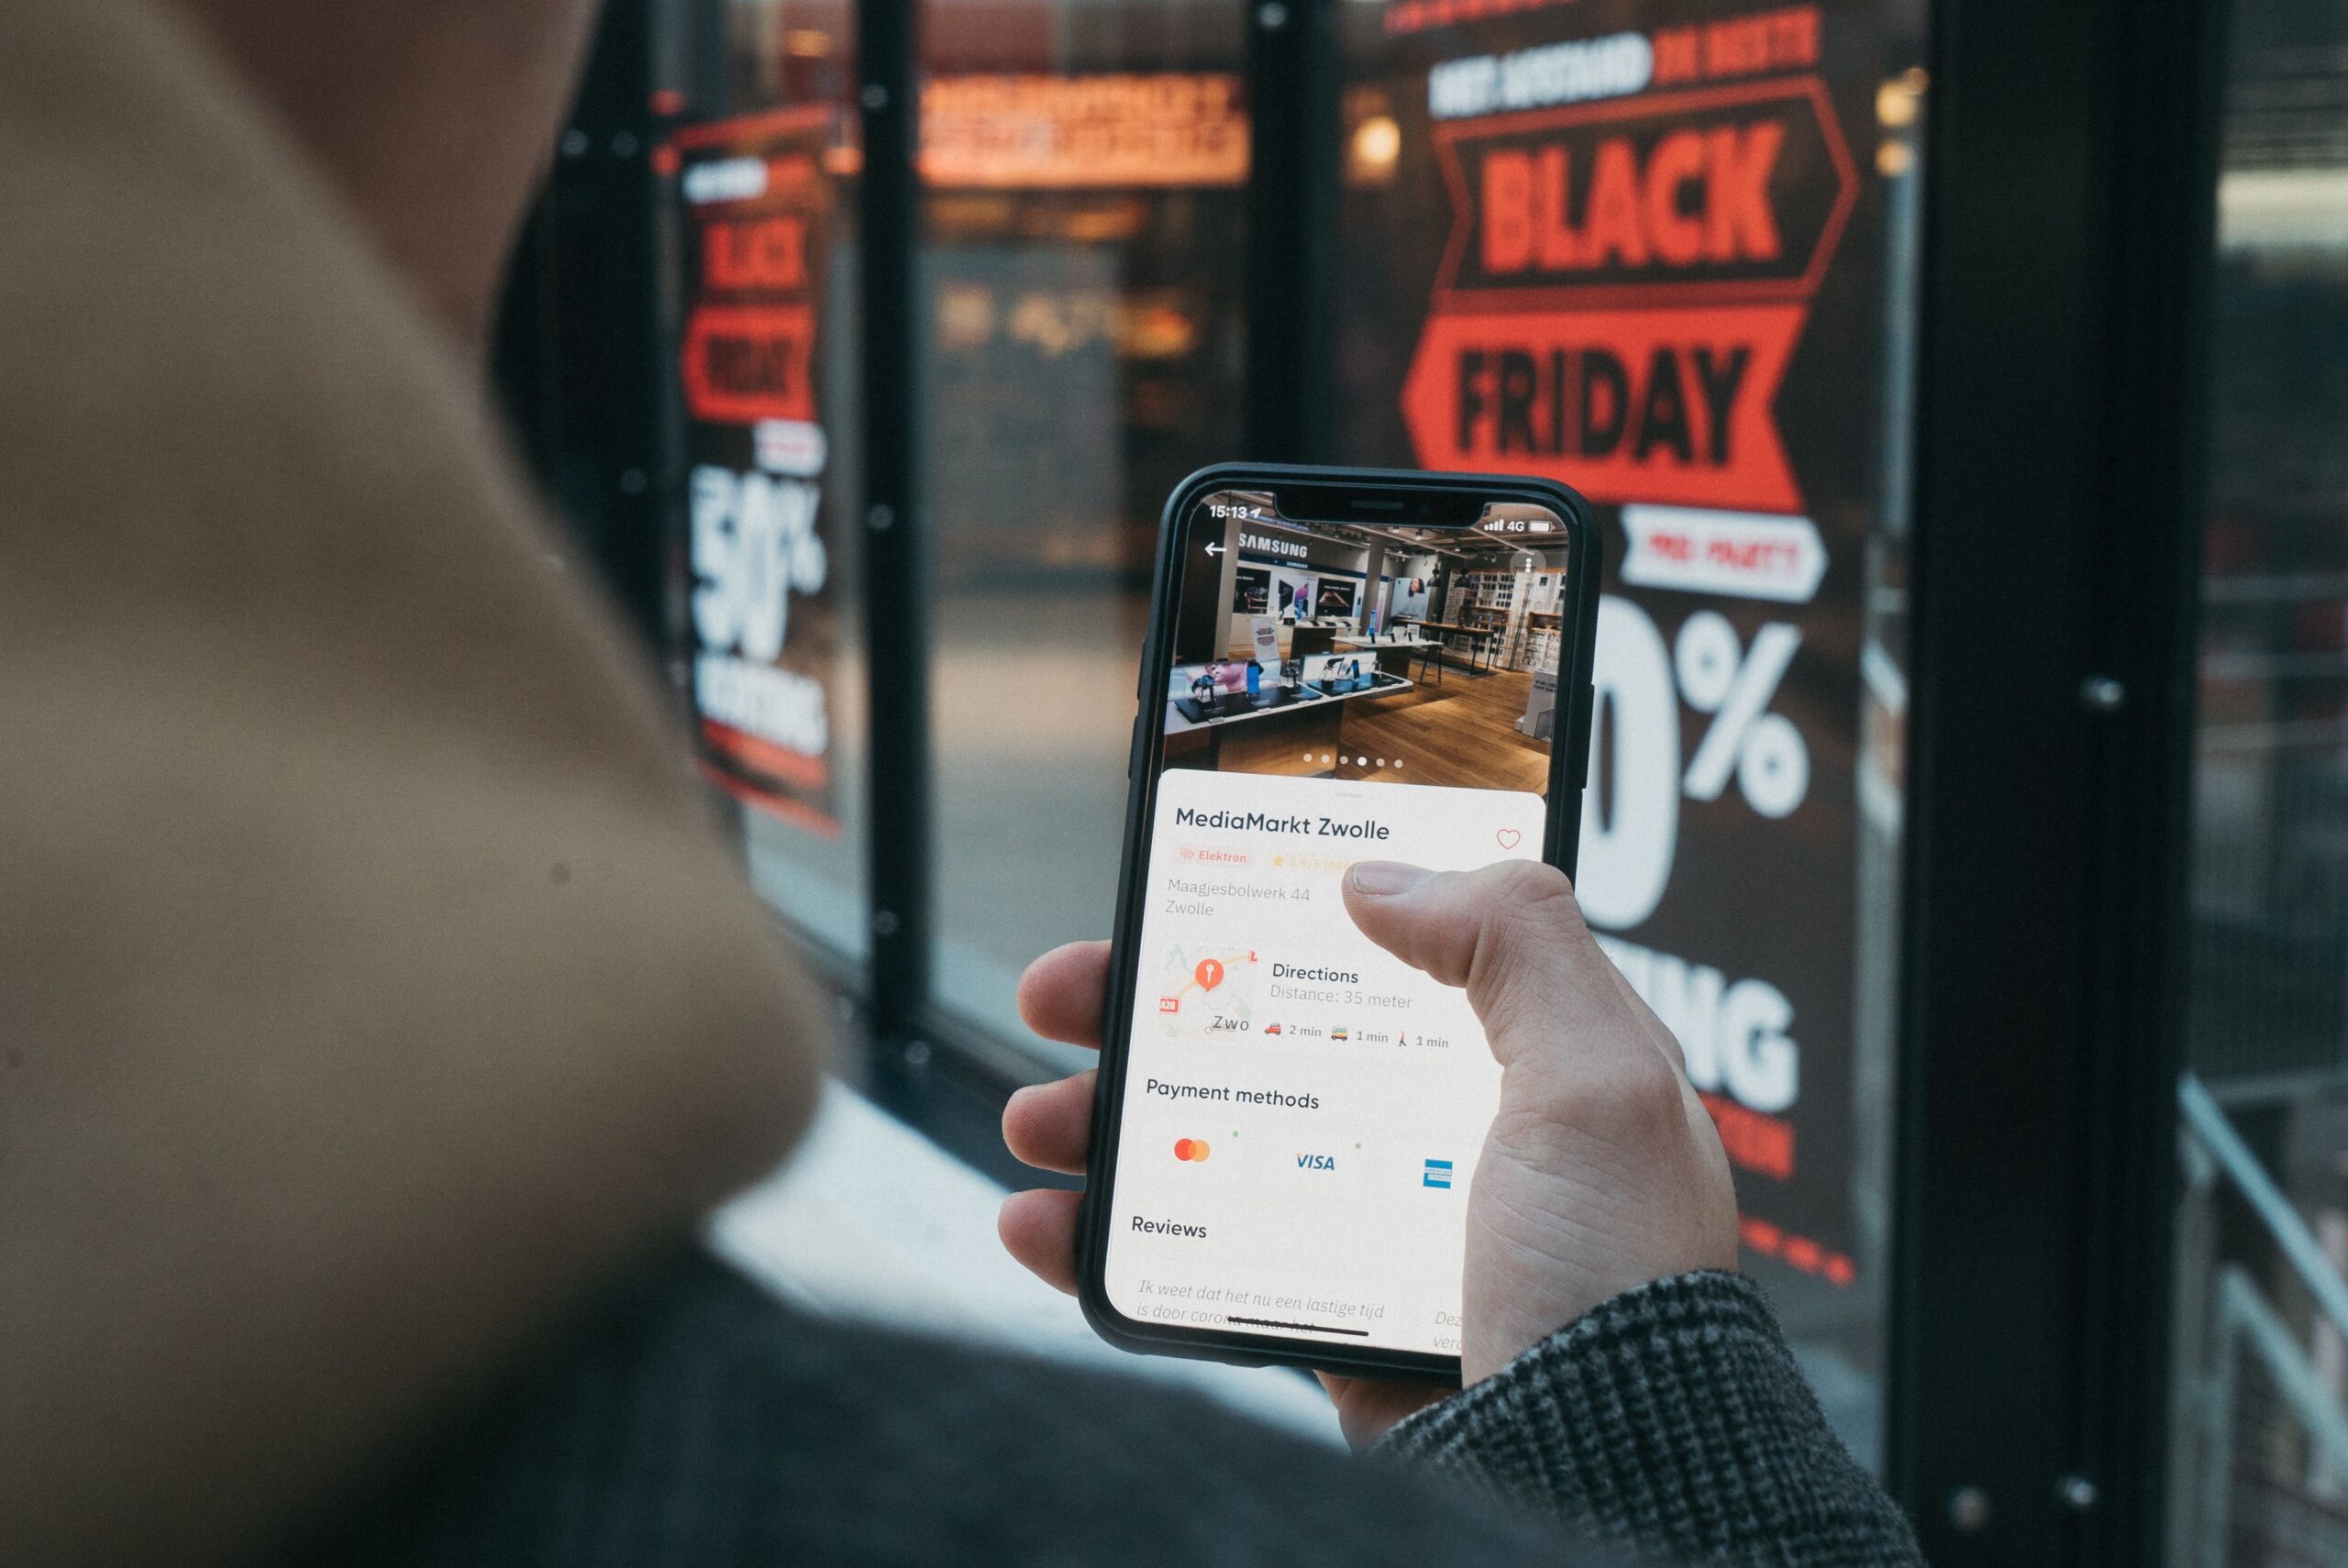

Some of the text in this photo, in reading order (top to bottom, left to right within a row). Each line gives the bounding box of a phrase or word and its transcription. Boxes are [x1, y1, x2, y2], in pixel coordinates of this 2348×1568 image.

[1480, 120, 1785, 271] BLACK
[1456, 345, 1752, 468] FRIDAY
[1210, 505, 1247, 519] 15:13
[1507, 521, 1524, 532] 4G
[1238, 533, 1308, 558] SAMSUNG
[1575, 595, 1811, 931] 0%
[1176, 808, 1390, 840] MediaMarkt Zwolle
[1199, 850, 1246, 863] Elektron
[1168, 879, 1310, 900] Maagjesbolwerk 44
[1165, 900, 1213, 915] Zwolle
[1273, 963, 1358, 984] Directions
[1270, 984, 1413, 1009] Distance: 35 meter
[1212, 1015, 1249, 1032] Zwo
[1290, 1024, 1322, 1037] 2 min
[1357, 1031, 1389, 1043] 1 min
[1416, 1035, 1448, 1048] 1 min
[1146, 1078, 1320, 1109] Payment methods
[1295, 1153, 1335, 1171] VISA
[1132, 1216, 1207, 1238] Reviews
[1138, 1279, 1386, 1320] Ik weet dat het nu een lastige tijd
[1136, 1302, 1148, 1317] is
[1153, 1304, 1188, 1320] door
